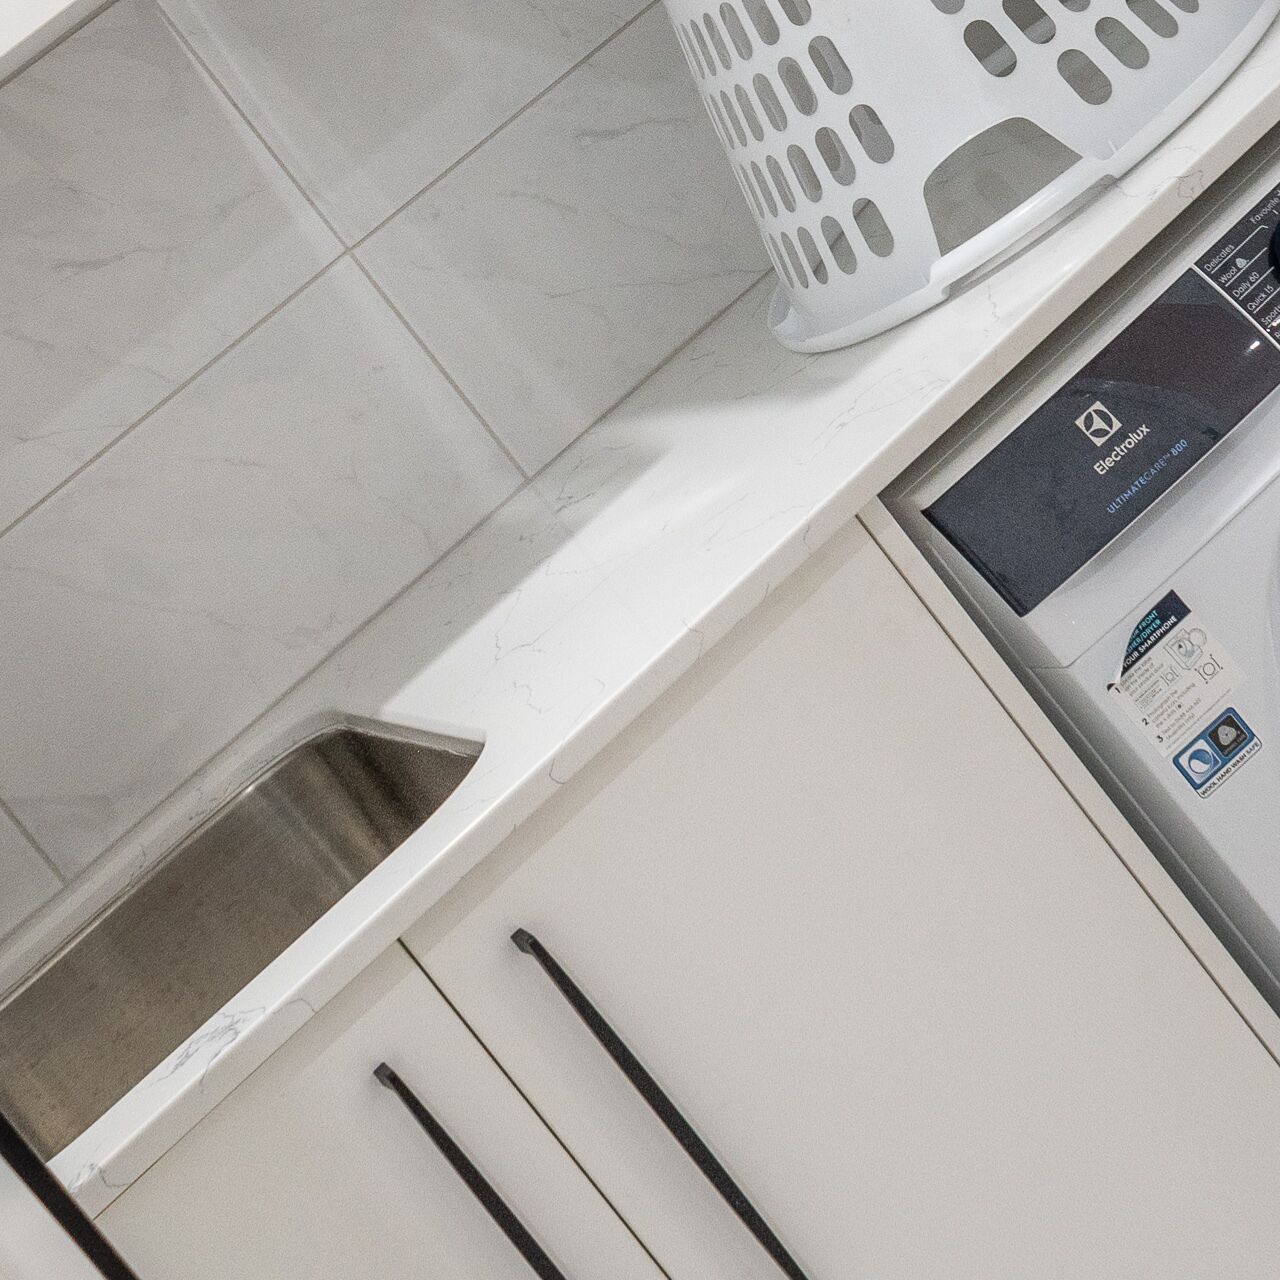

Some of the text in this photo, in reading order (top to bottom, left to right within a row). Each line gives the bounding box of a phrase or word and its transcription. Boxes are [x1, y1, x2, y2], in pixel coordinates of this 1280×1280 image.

[1249, 195, 1280, 225] Favourite
[1204, 243, 1234, 271] Delicates
[1218, 265, 1238, 284] Wool
[1232, 270, 1259, 298] Daily 60
[1246, 285, 1274, 311] Quick 15
[1092, 421, 1150, 475] Electrolux
[1169, 438, 1188, 456] 800
[1137, 609, 1158, 629] FRONT
[1137, 614, 1177, 652] SMARTPHONE
[1141, 717, 1149, 725] 2
[1155, 734, 1164, 743] 3
[1200, 780, 1217, 796] WOOL
[1216, 766, 1231, 781] HAND
[1230, 752, 1246, 768] WASH
[1244, 740, 1259, 754] SAFE
